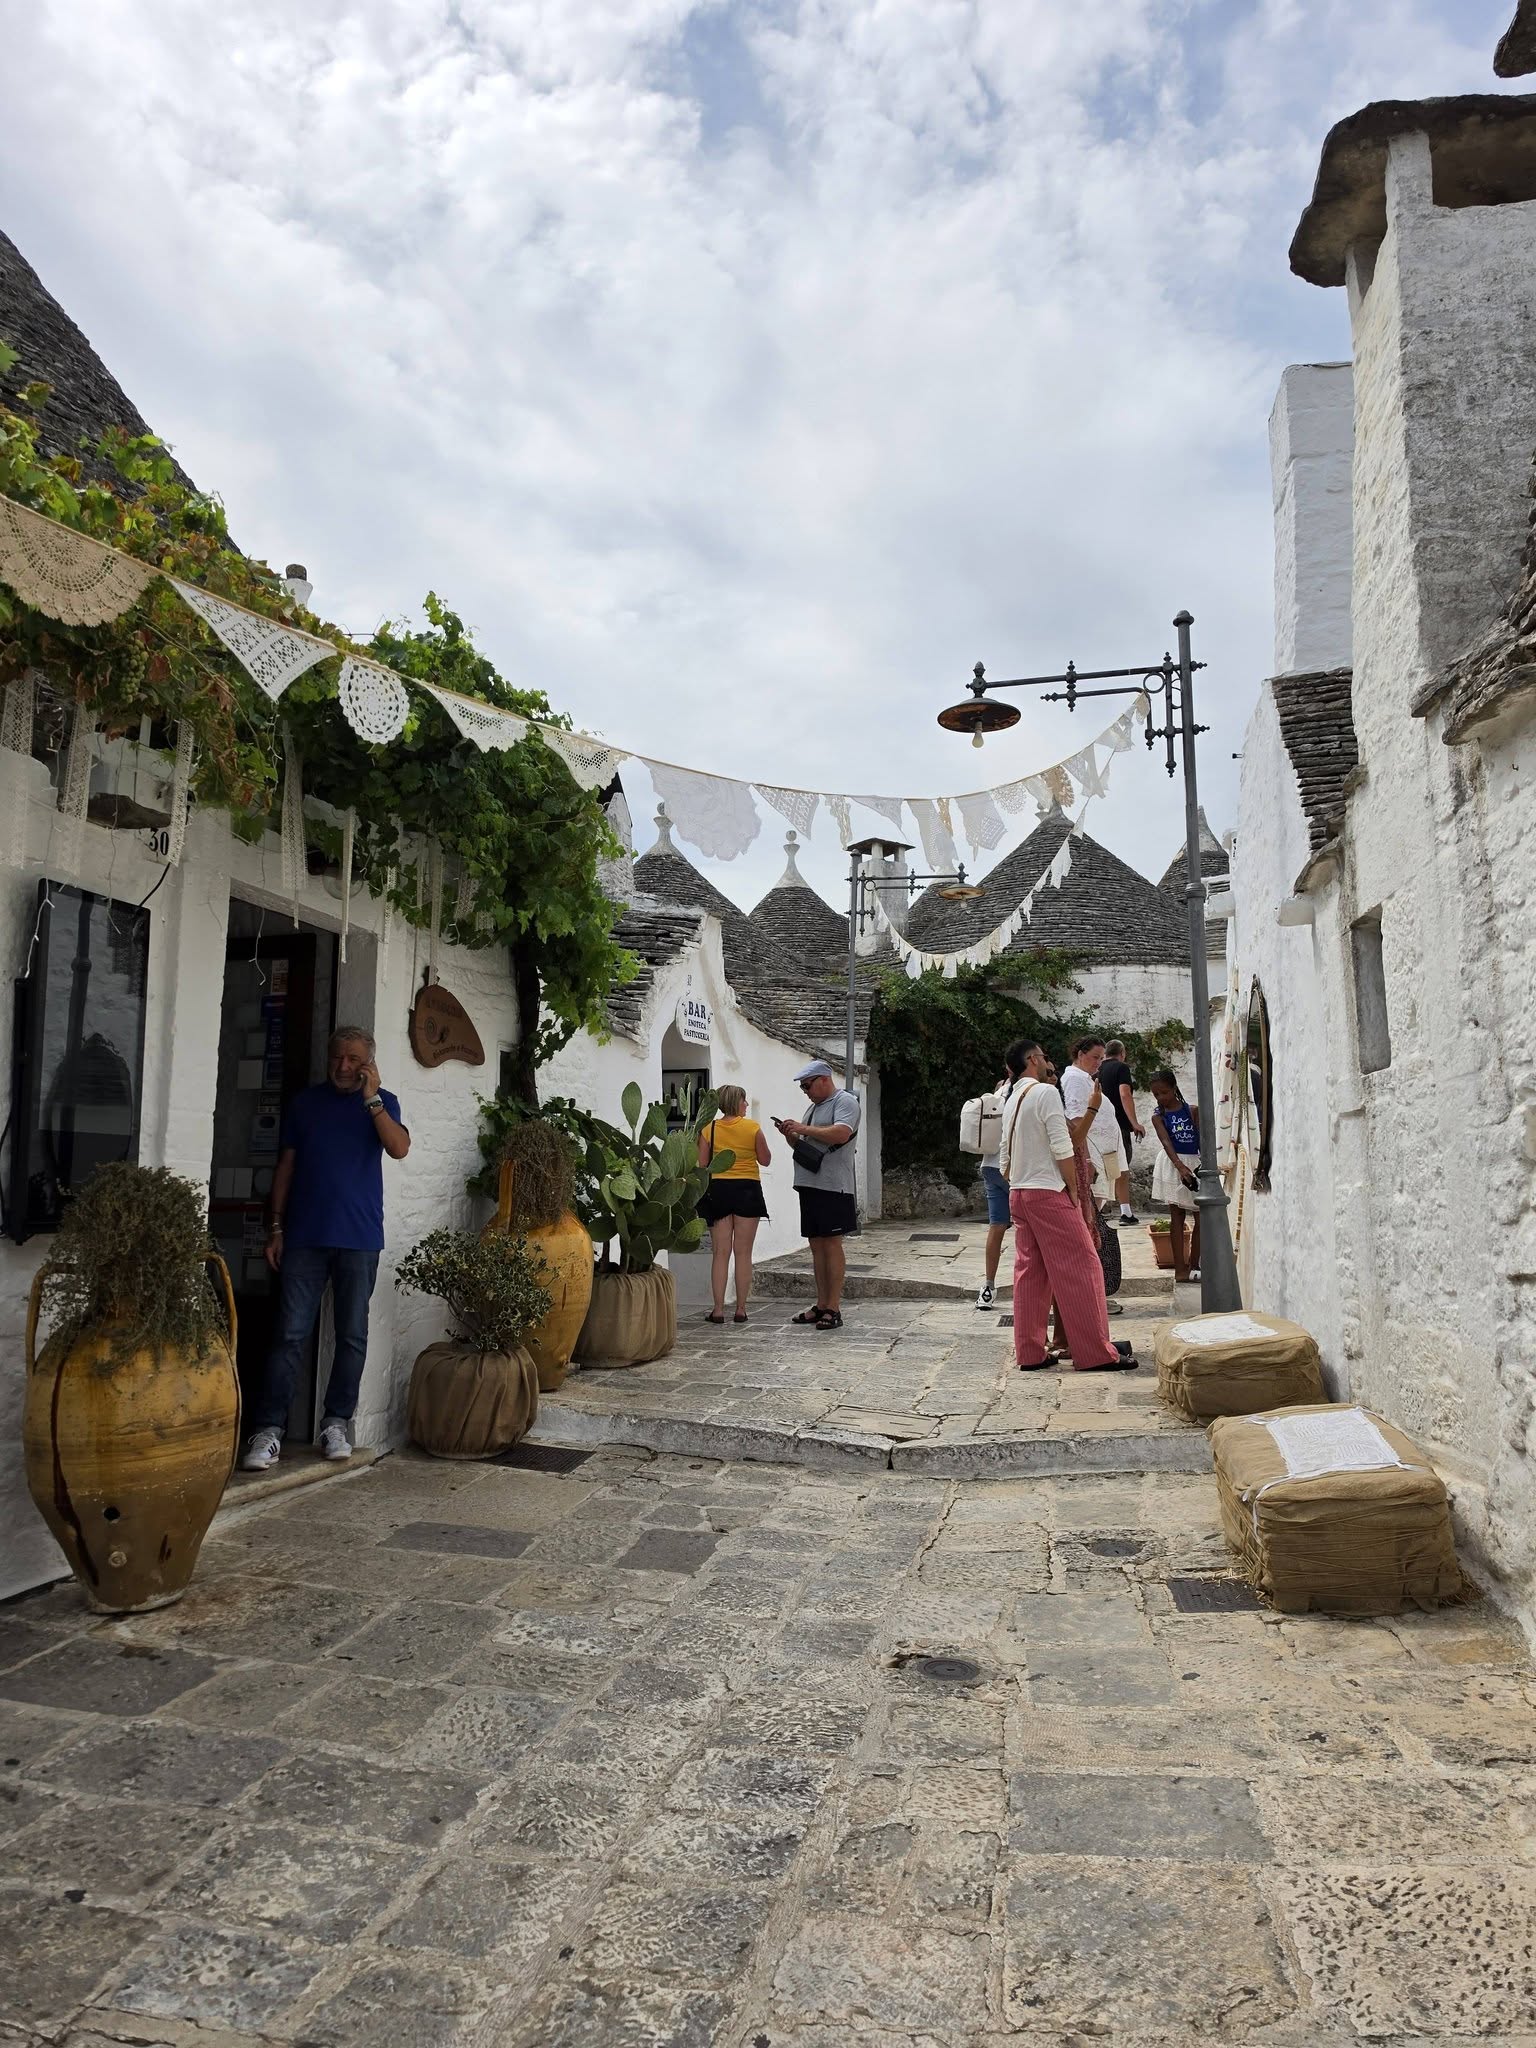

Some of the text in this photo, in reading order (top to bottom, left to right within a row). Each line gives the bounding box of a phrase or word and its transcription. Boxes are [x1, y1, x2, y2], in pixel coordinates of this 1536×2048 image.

[149, 827, 169, 856] 30
[688, 1001, 706, 1020] BAR
[688, 1019, 706, 1030] ENOTECA
[684, 1029, 709, 1041] PASTICCERIA
[1171, 1115, 1189, 1124] la
[1174, 1131, 1194, 1140] vita
